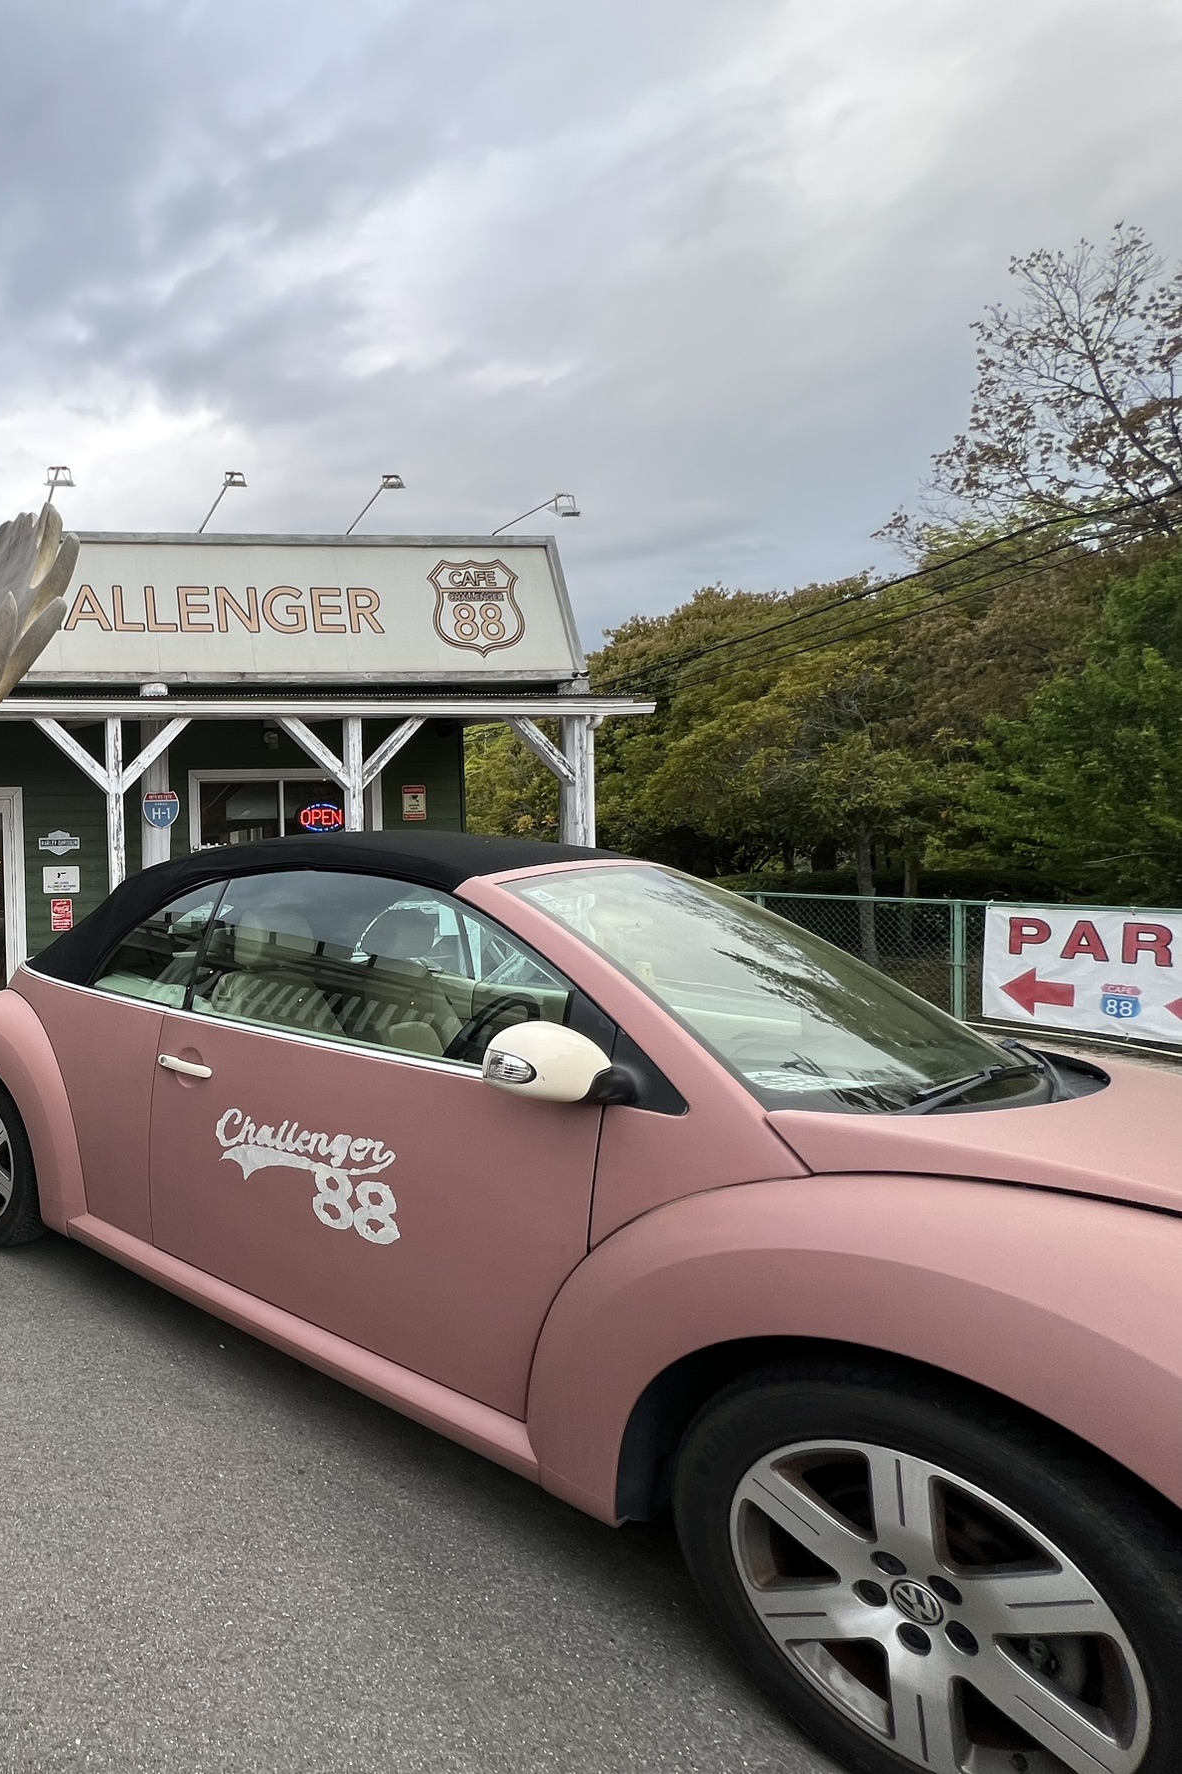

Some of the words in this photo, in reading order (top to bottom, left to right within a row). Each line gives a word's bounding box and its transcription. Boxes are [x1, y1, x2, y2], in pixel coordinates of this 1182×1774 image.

[448, 570, 498, 587] CAFE
[447, 591, 505, 602] CHALLENGER
[58, 584, 386, 635] ALLENGER
[453, 602, 506, 641] 88
[152, 807, 171, 820] H-1
[300, 809, 342, 826] OPEN
[1107, 985, 1134, 994] CAFE
[1106, 998, 1133, 1017] 88
[215, 1107, 396, 1175] Challenger
[312, 1162, 401, 1245] 88
